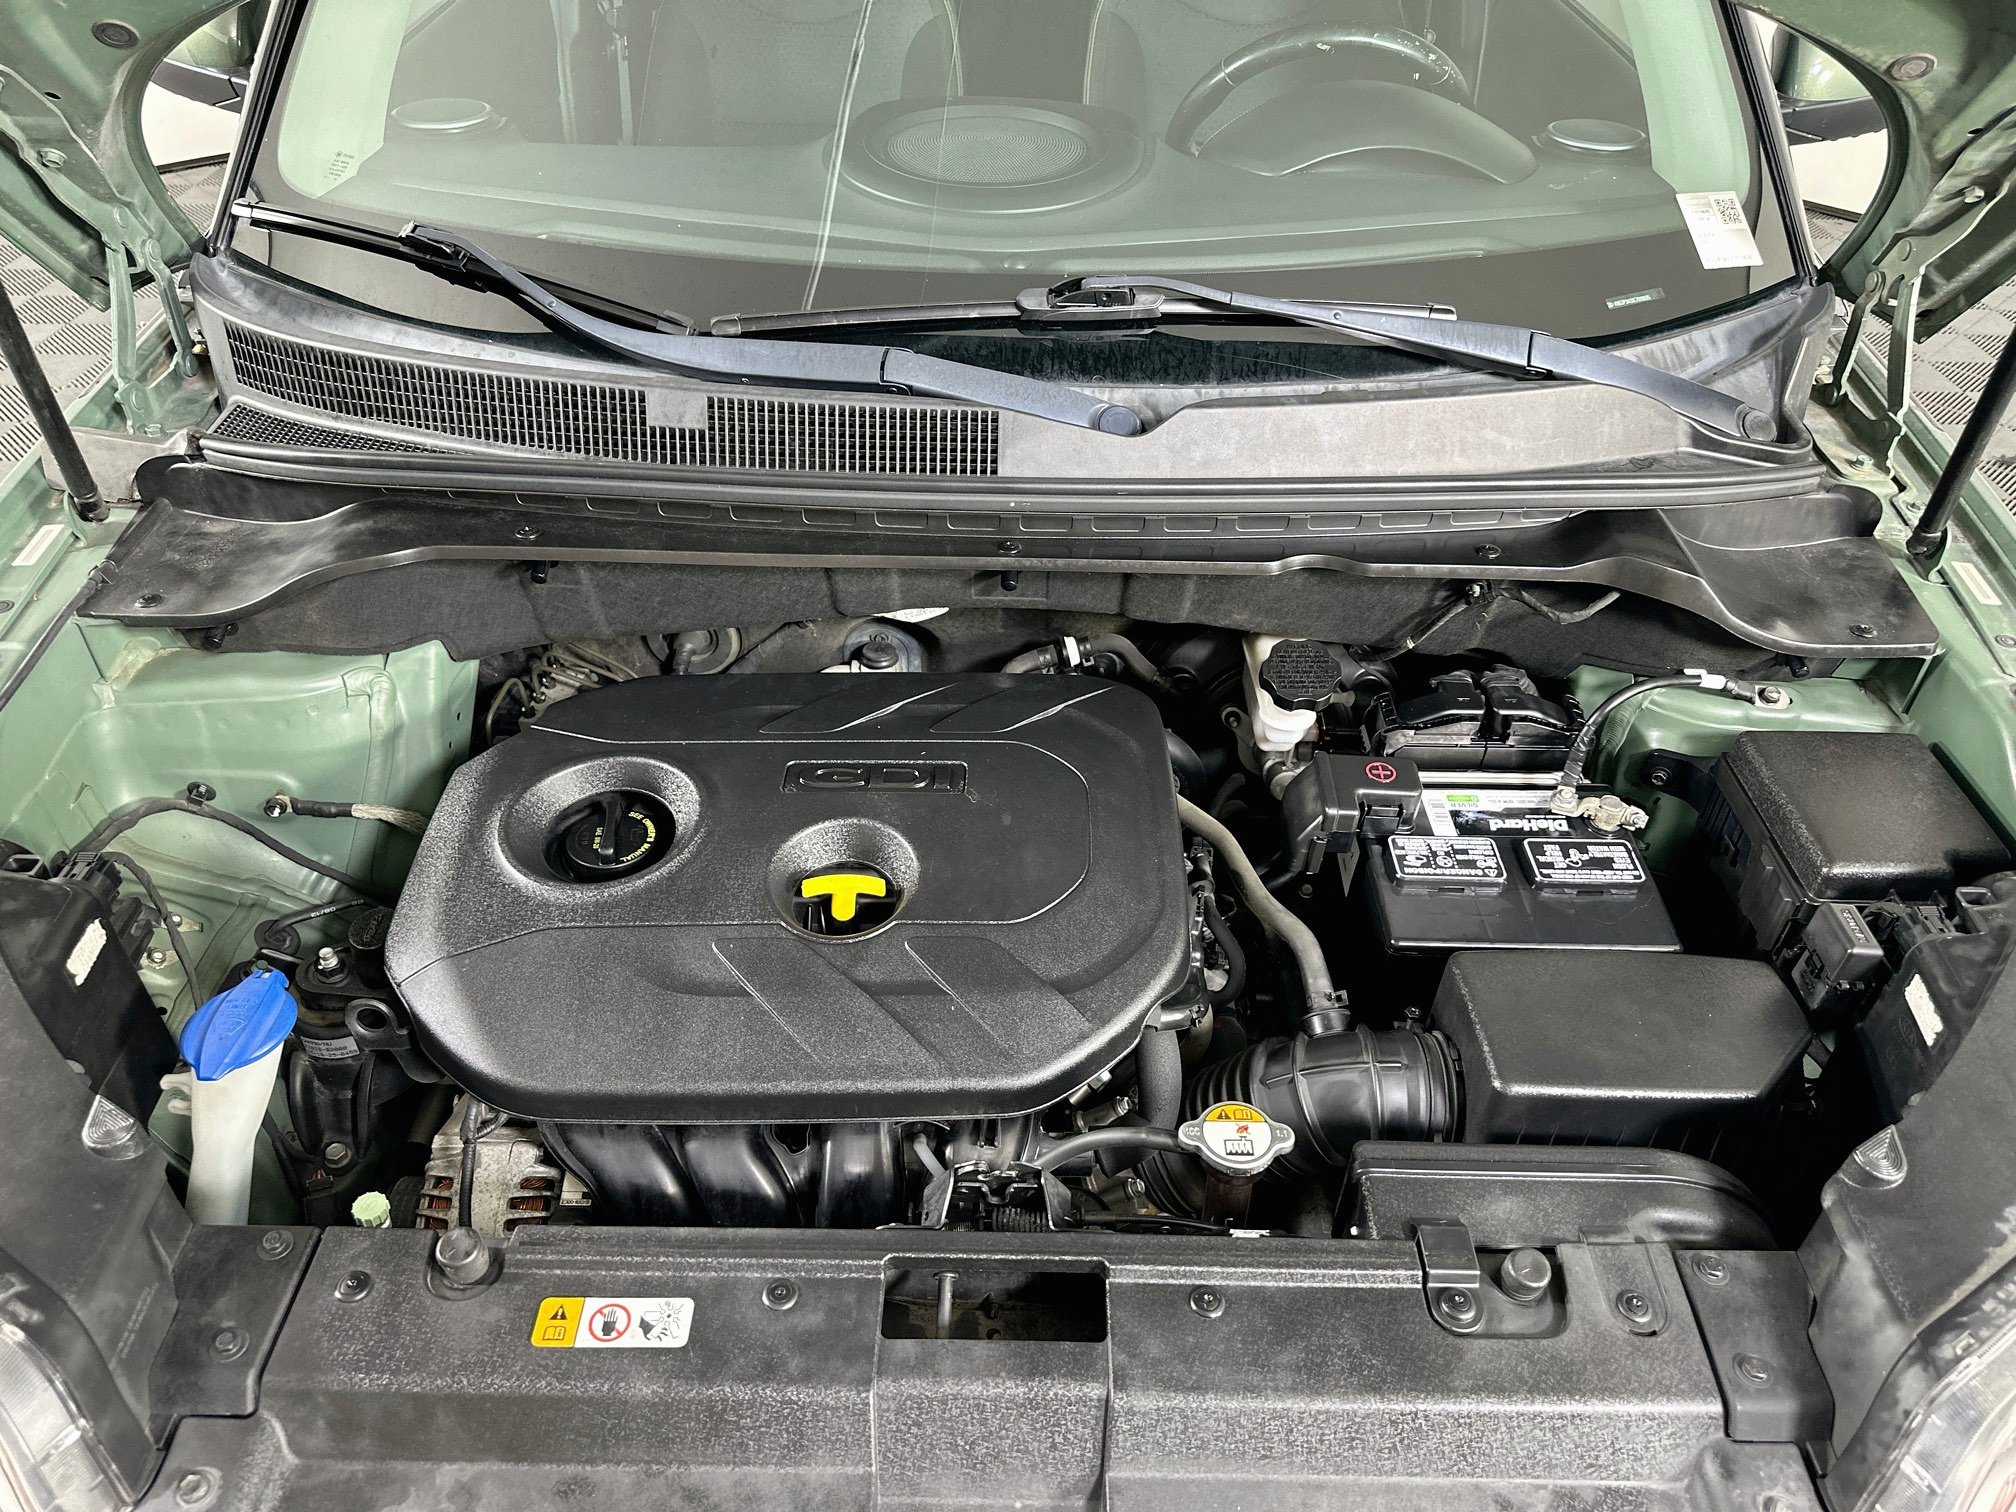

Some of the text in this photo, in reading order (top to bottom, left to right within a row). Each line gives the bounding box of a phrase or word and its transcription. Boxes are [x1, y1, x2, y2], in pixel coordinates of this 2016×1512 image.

[798, 767, 951, 789] GDI
[628, 811, 645, 820] SEE
[1487, 818, 1569, 832] DieHard
[620, 843, 651, 862] MANUAL
[311, 906, 336, 917] 08/13
